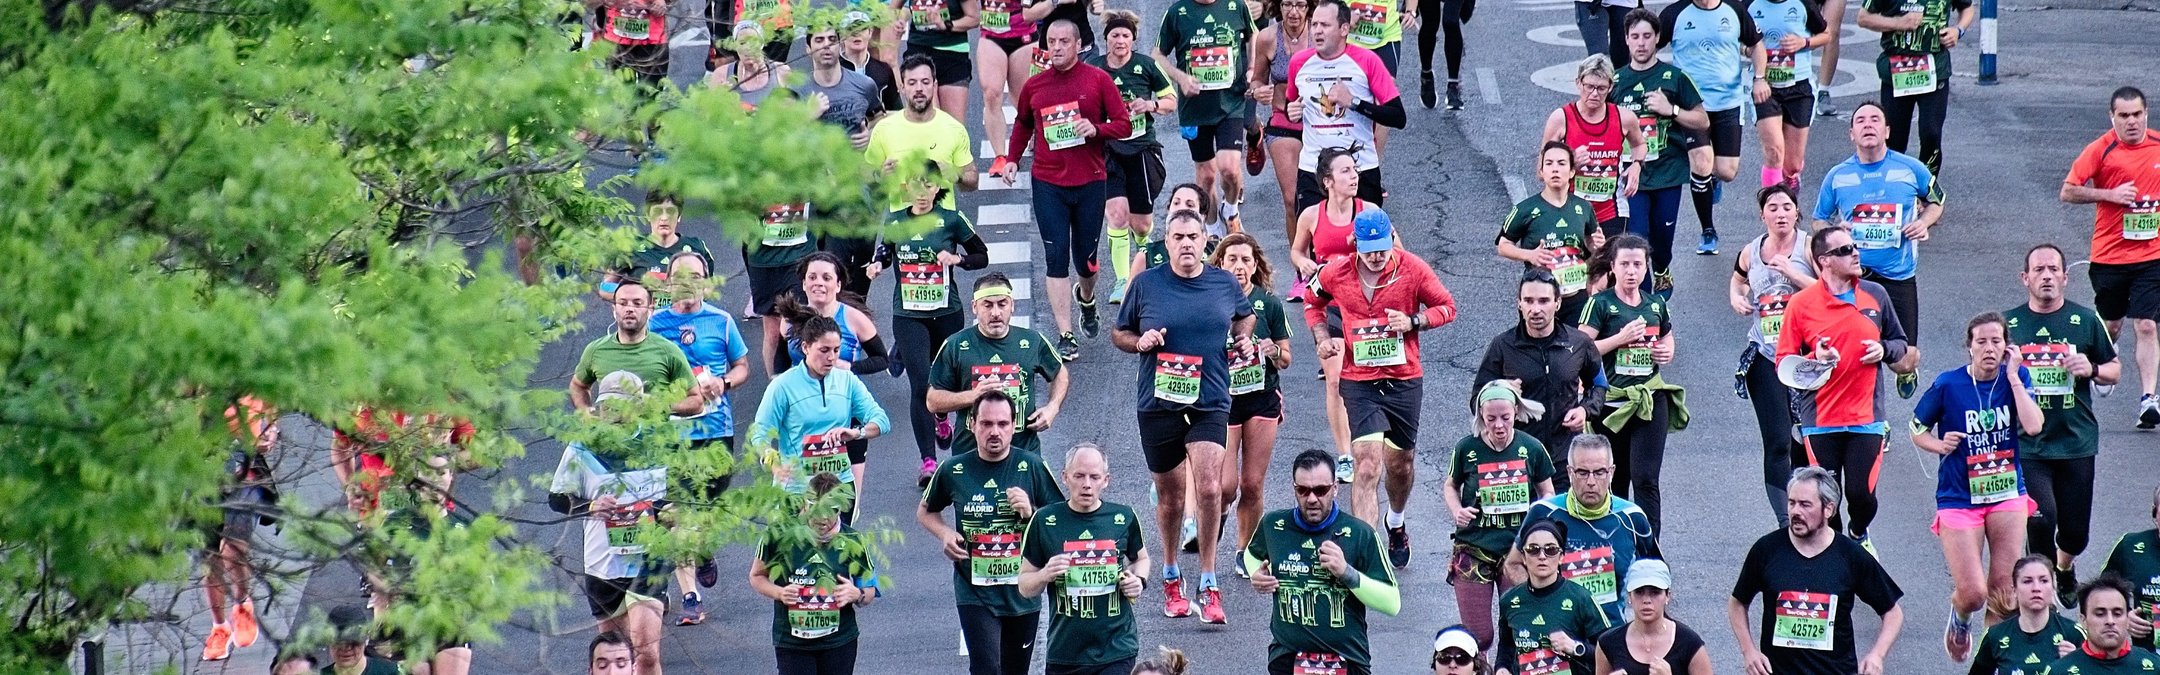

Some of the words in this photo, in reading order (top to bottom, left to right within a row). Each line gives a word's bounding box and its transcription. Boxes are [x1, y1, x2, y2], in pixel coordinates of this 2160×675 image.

[1190, 36, 1214, 44] MADRID
[1204, 71, 1223, 81] 40802
[1588, 150, 1618, 160] NMARK
[1866, 228, 1887, 239] 26301
[1368, 344, 1391, 357] 43163
[1233, 372, 1254, 386] 40901
[2037, 373, 2062, 385] 42954
[1167, 380, 1191, 394] 42936
[1967, 433, 1992, 449] FOR
[1992, 430, 2010, 444] THE
[972, 493, 985, 503] edp
[963, 504, 994, 513] MADRID
[1288, 552, 1300, 562] edp
[987, 563, 1012, 576] 42804
[1278, 562, 1309, 574] MADRID
[789, 576, 816, 585] MADRID
[1082, 571, 1108, 585] 41756
[1791, 623, 1817, 638] 42572
